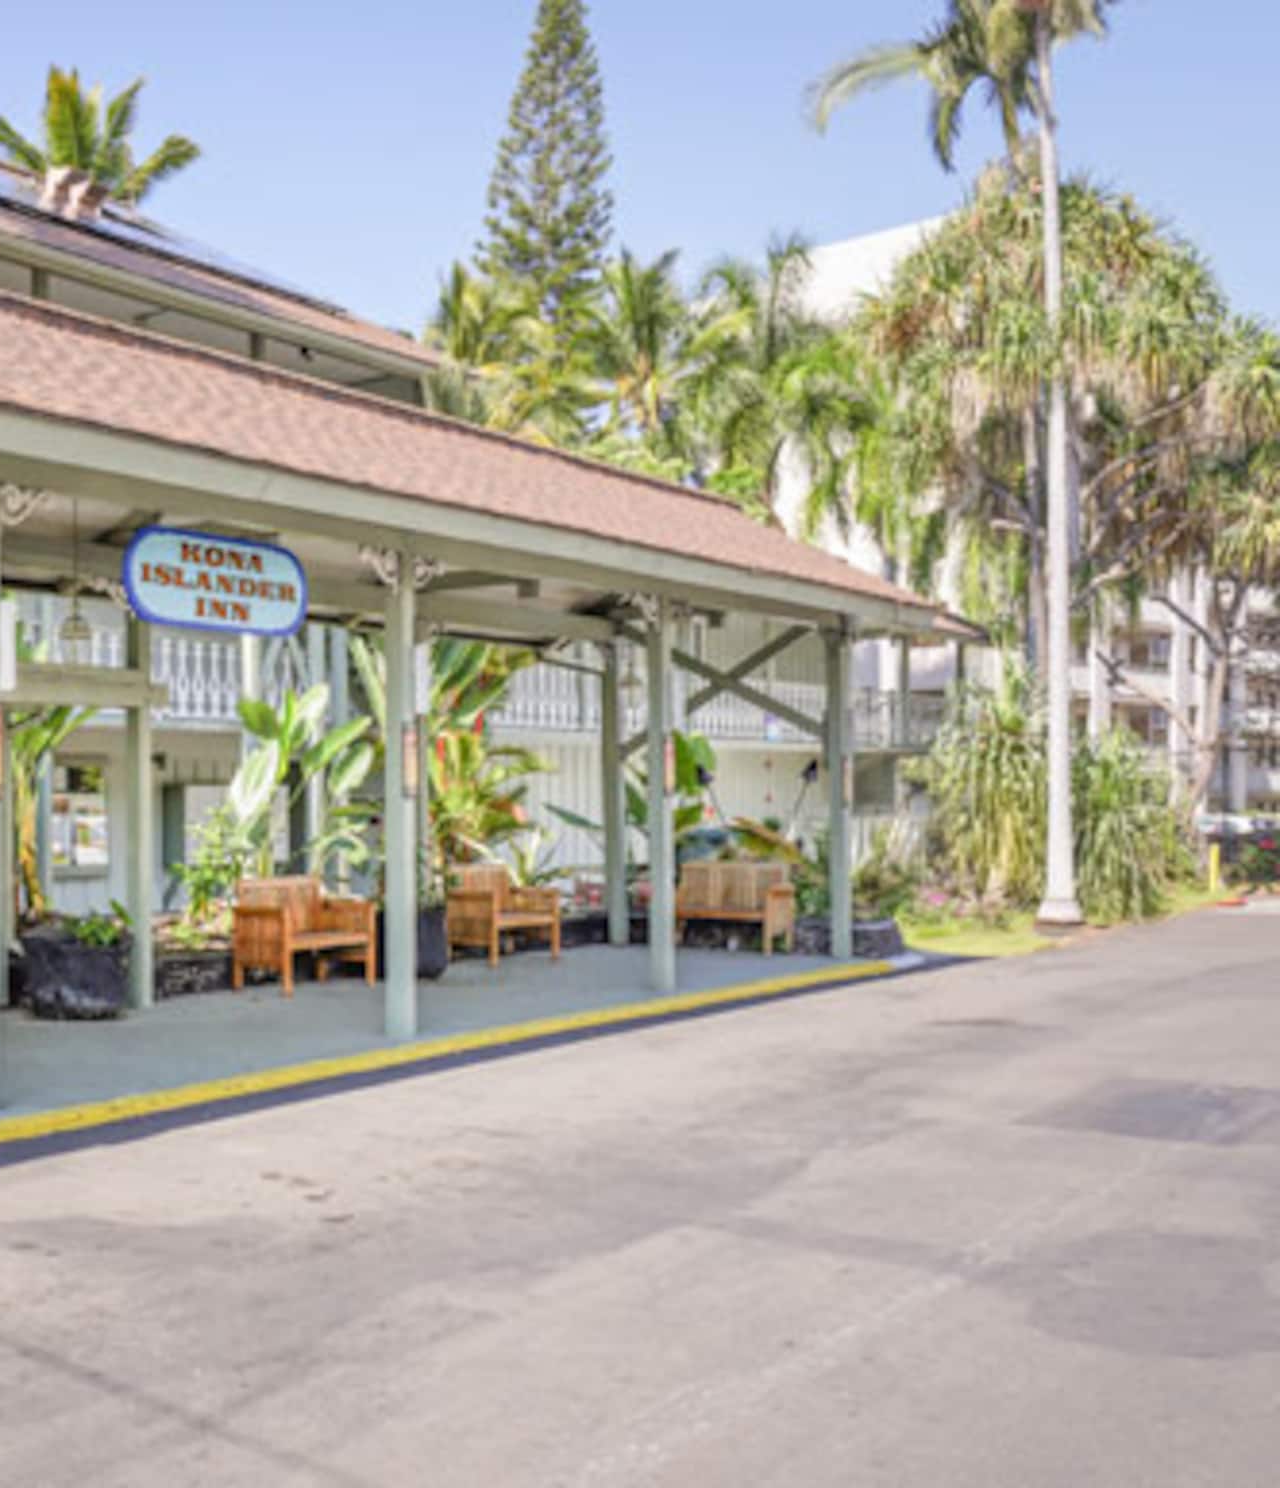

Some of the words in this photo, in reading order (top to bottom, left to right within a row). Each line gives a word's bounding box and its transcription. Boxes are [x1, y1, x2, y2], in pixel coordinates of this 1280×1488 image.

[181, 542, 263, 573] KONA
[141, 562, 296, 601] ISLANDER
[195, 597, 249, 620] INN
